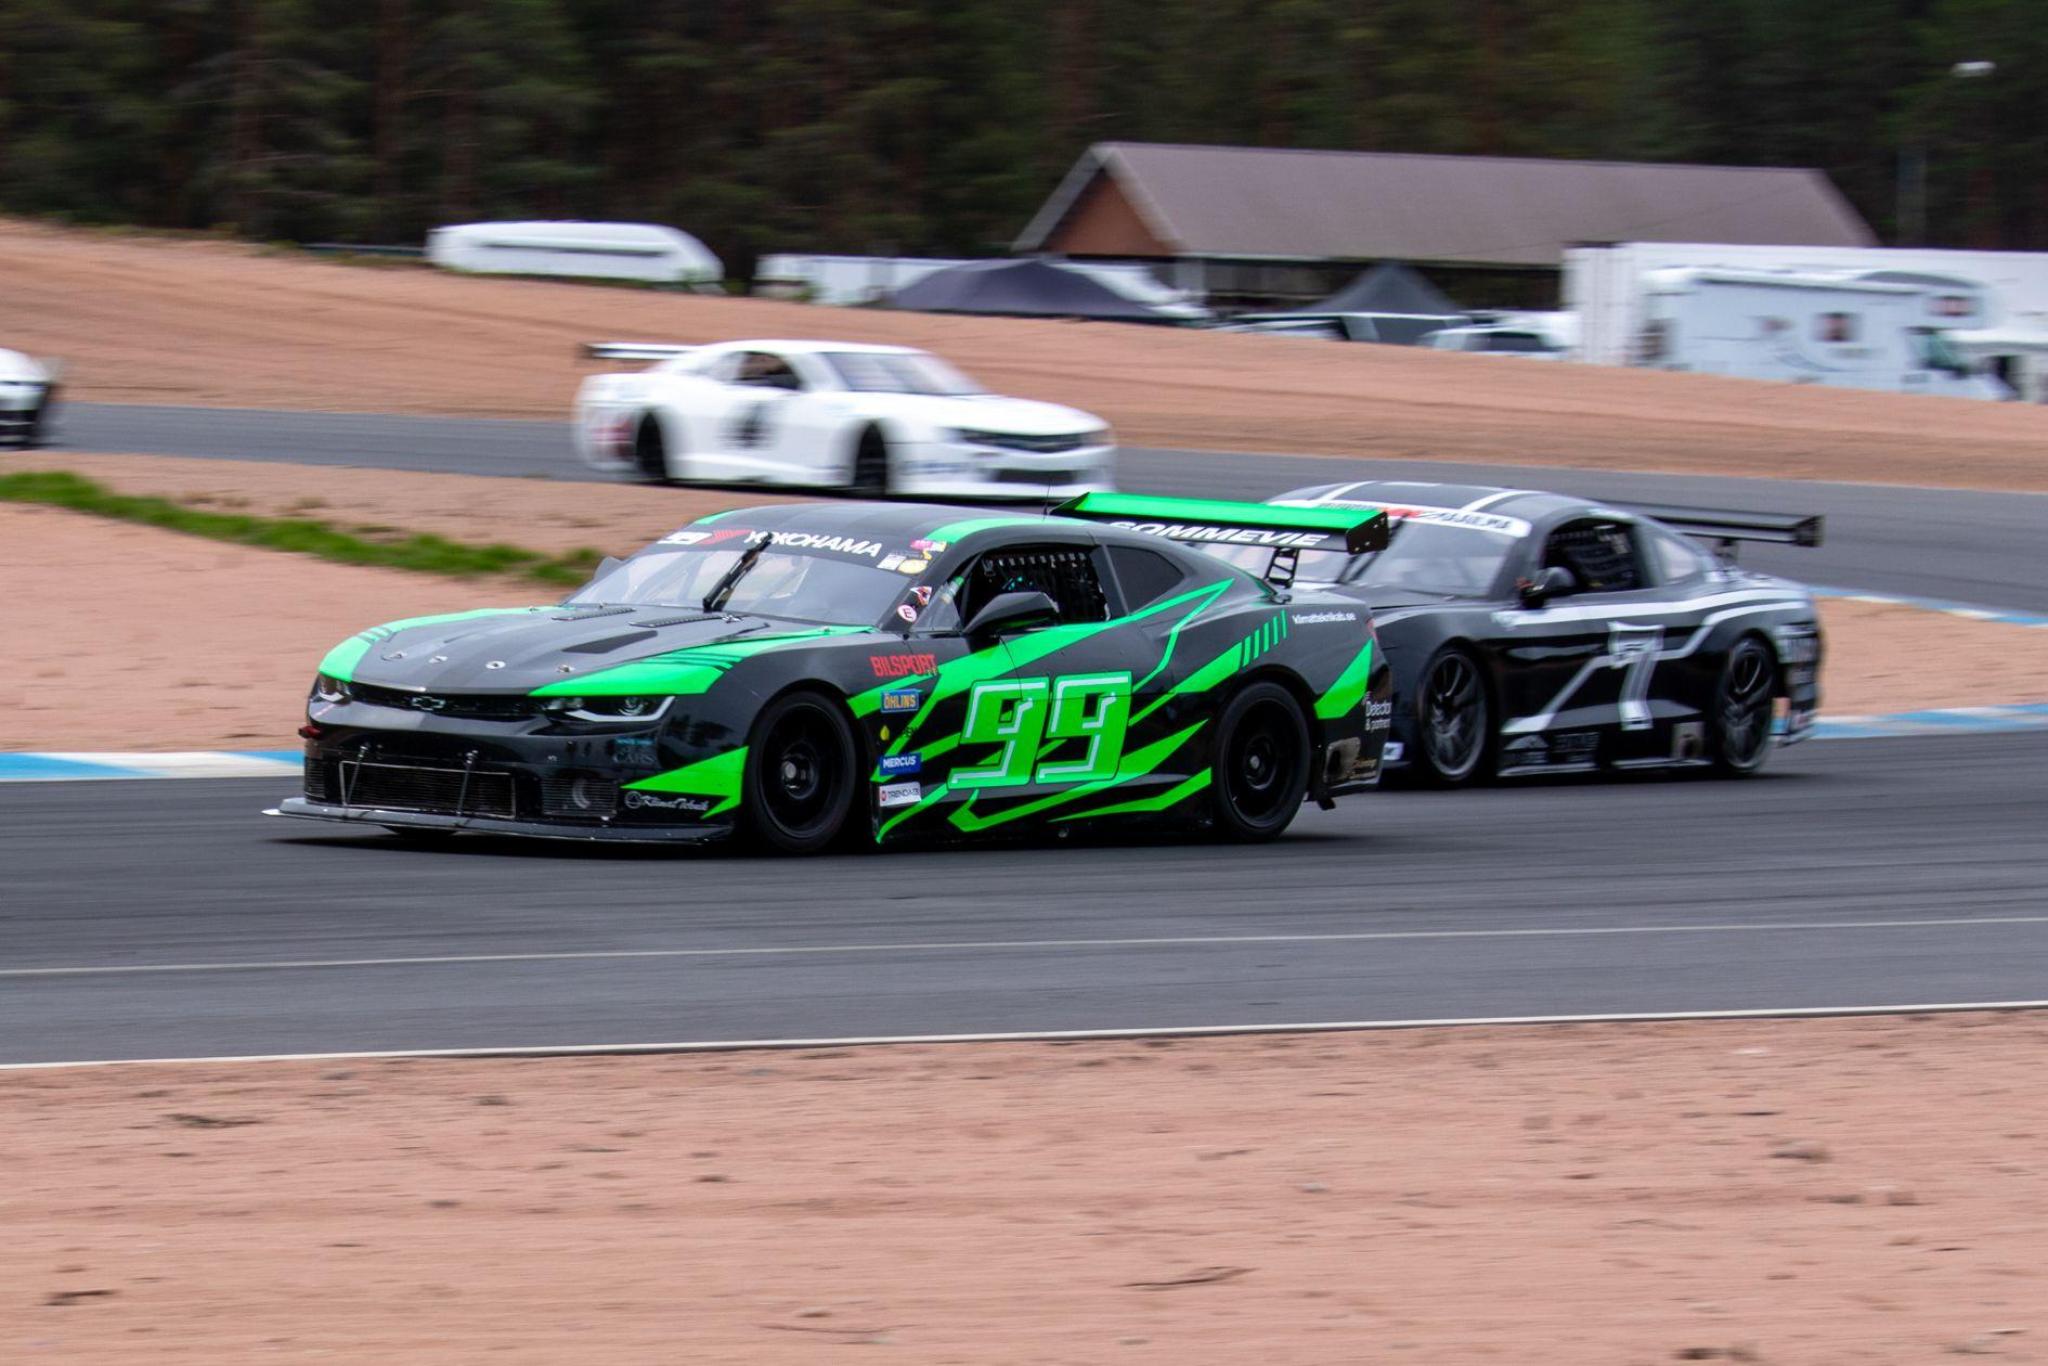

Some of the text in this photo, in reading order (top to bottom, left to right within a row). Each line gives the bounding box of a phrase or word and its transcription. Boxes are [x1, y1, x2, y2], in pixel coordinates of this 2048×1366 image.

[870, 654, 935, 677] BILSPORT
[947, 671, 1132, 789] 99
[883, 755, 917, 769] MERCUS
